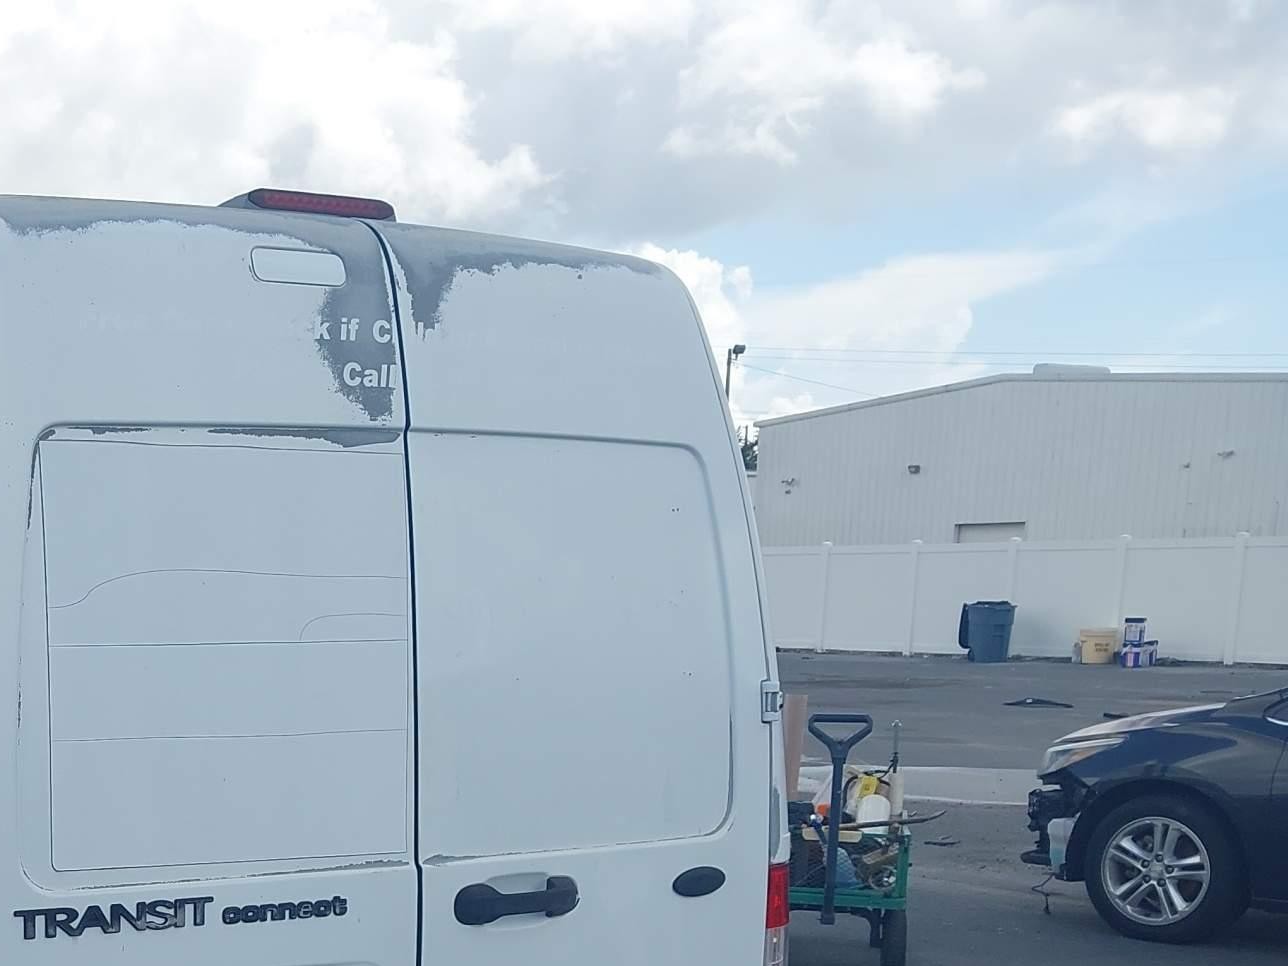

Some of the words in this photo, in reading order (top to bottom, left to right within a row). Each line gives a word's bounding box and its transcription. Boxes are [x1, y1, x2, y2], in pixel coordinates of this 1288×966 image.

[340, 317, 360, 341] if
[343, 361, 397, 388] Call
[13, 896, 214, 941] TRANSIT
[221, 896, 348, 926] connect
